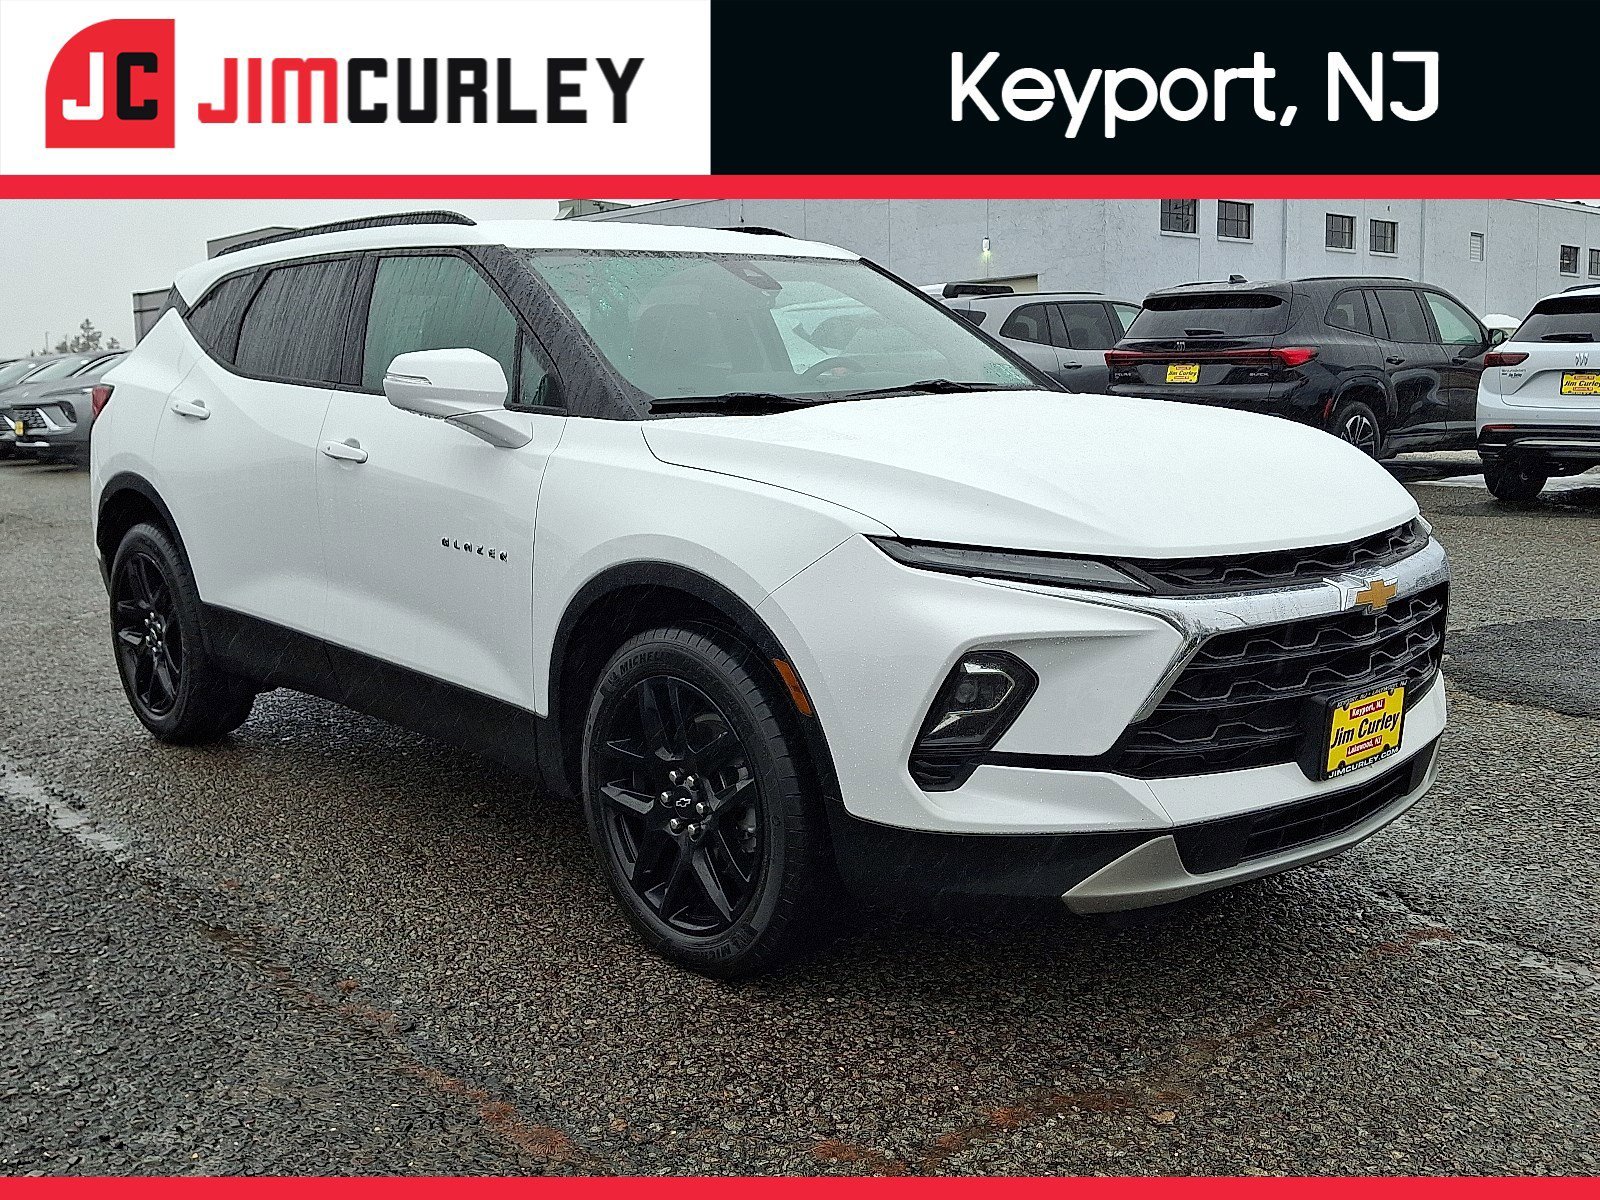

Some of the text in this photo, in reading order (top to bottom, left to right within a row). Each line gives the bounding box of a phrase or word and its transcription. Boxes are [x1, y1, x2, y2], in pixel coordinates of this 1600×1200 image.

[441, 537, 508, 564] BLAZER
[1331, 712, 1401, 749] Jim Curley
[1328, 746, 1399, 778] JIMCURLEY.COM
